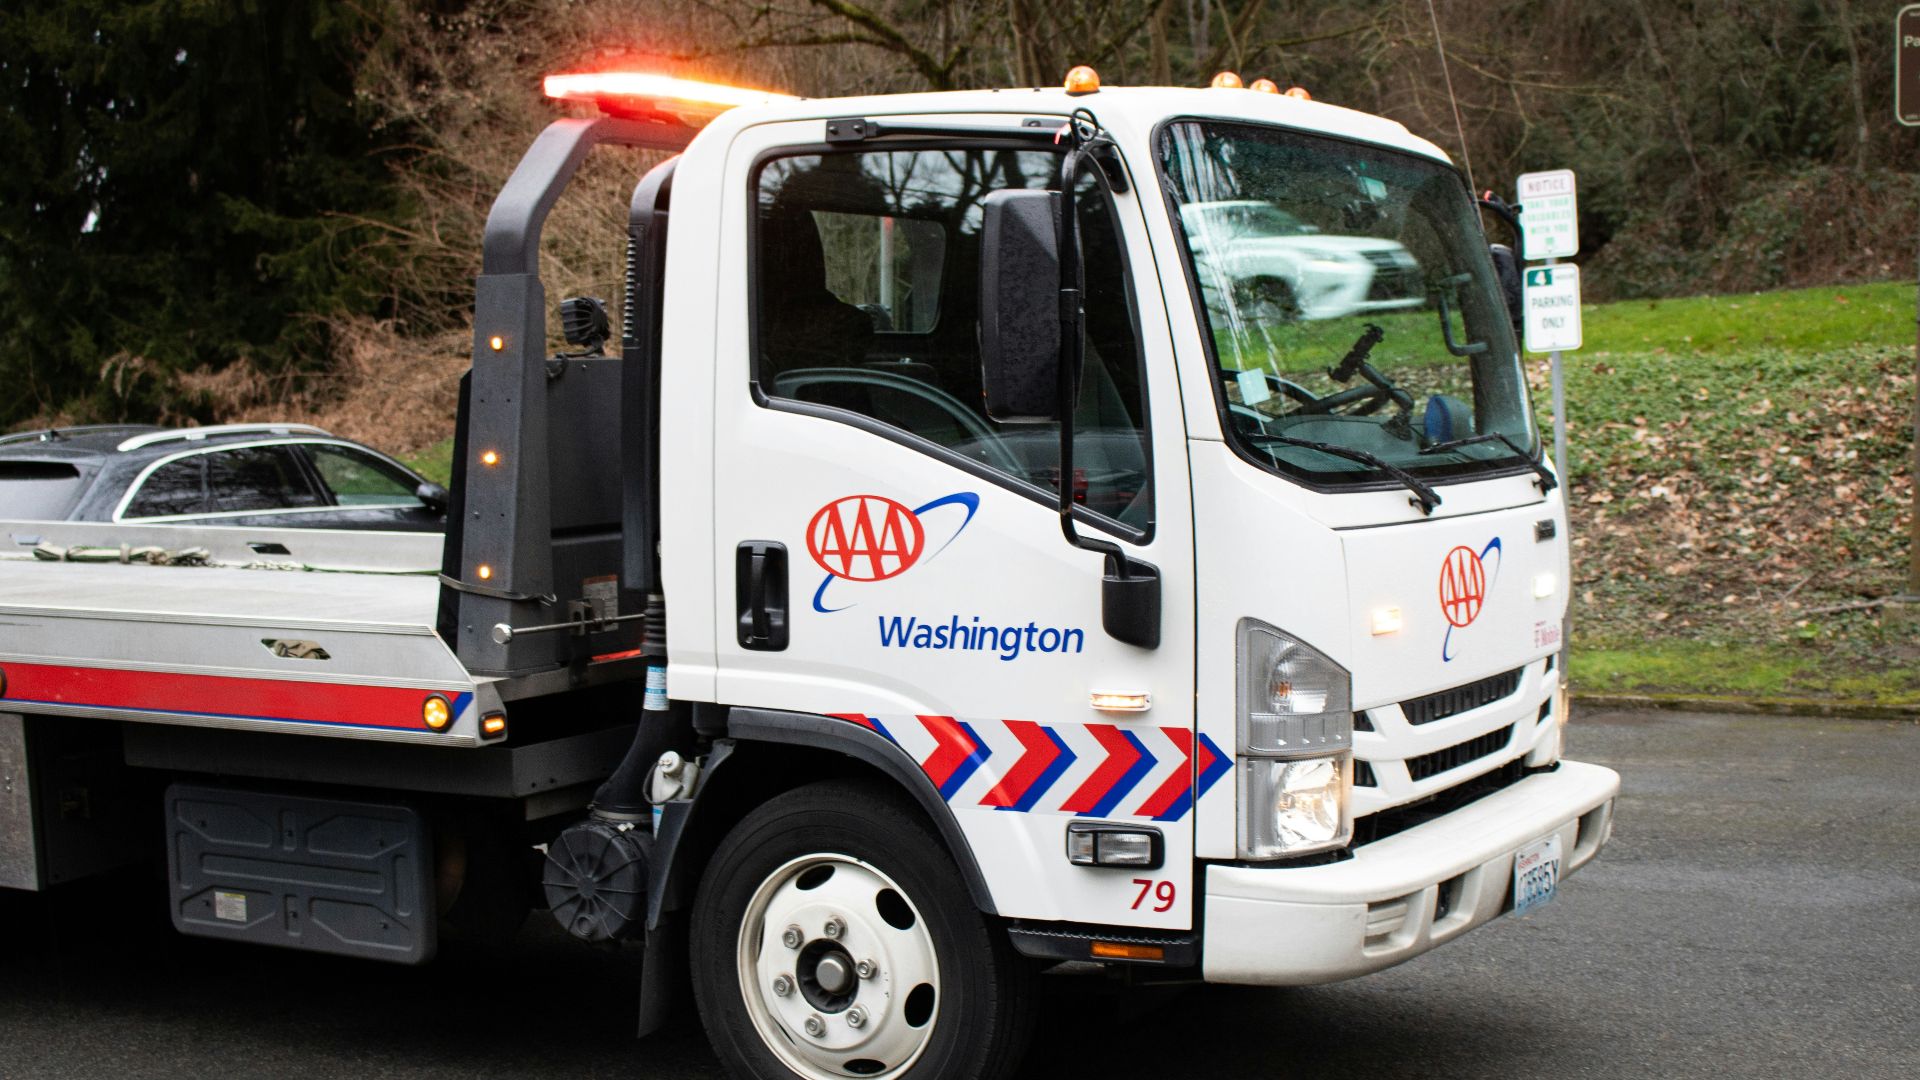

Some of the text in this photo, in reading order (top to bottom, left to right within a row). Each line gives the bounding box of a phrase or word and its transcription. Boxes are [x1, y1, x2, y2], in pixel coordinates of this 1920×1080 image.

[1528, 179, 1565, 193] NOTICE
[1532, 295, 1573, 308] PARKING
[1542, 317, 1565, 329] ONLY
[814, 496, 914, 579] AAA
[1444, 550, 1481, 624] AAA
[879, 615, 1084, 661] Washington
[1131, 879, 1176, 913] 79
